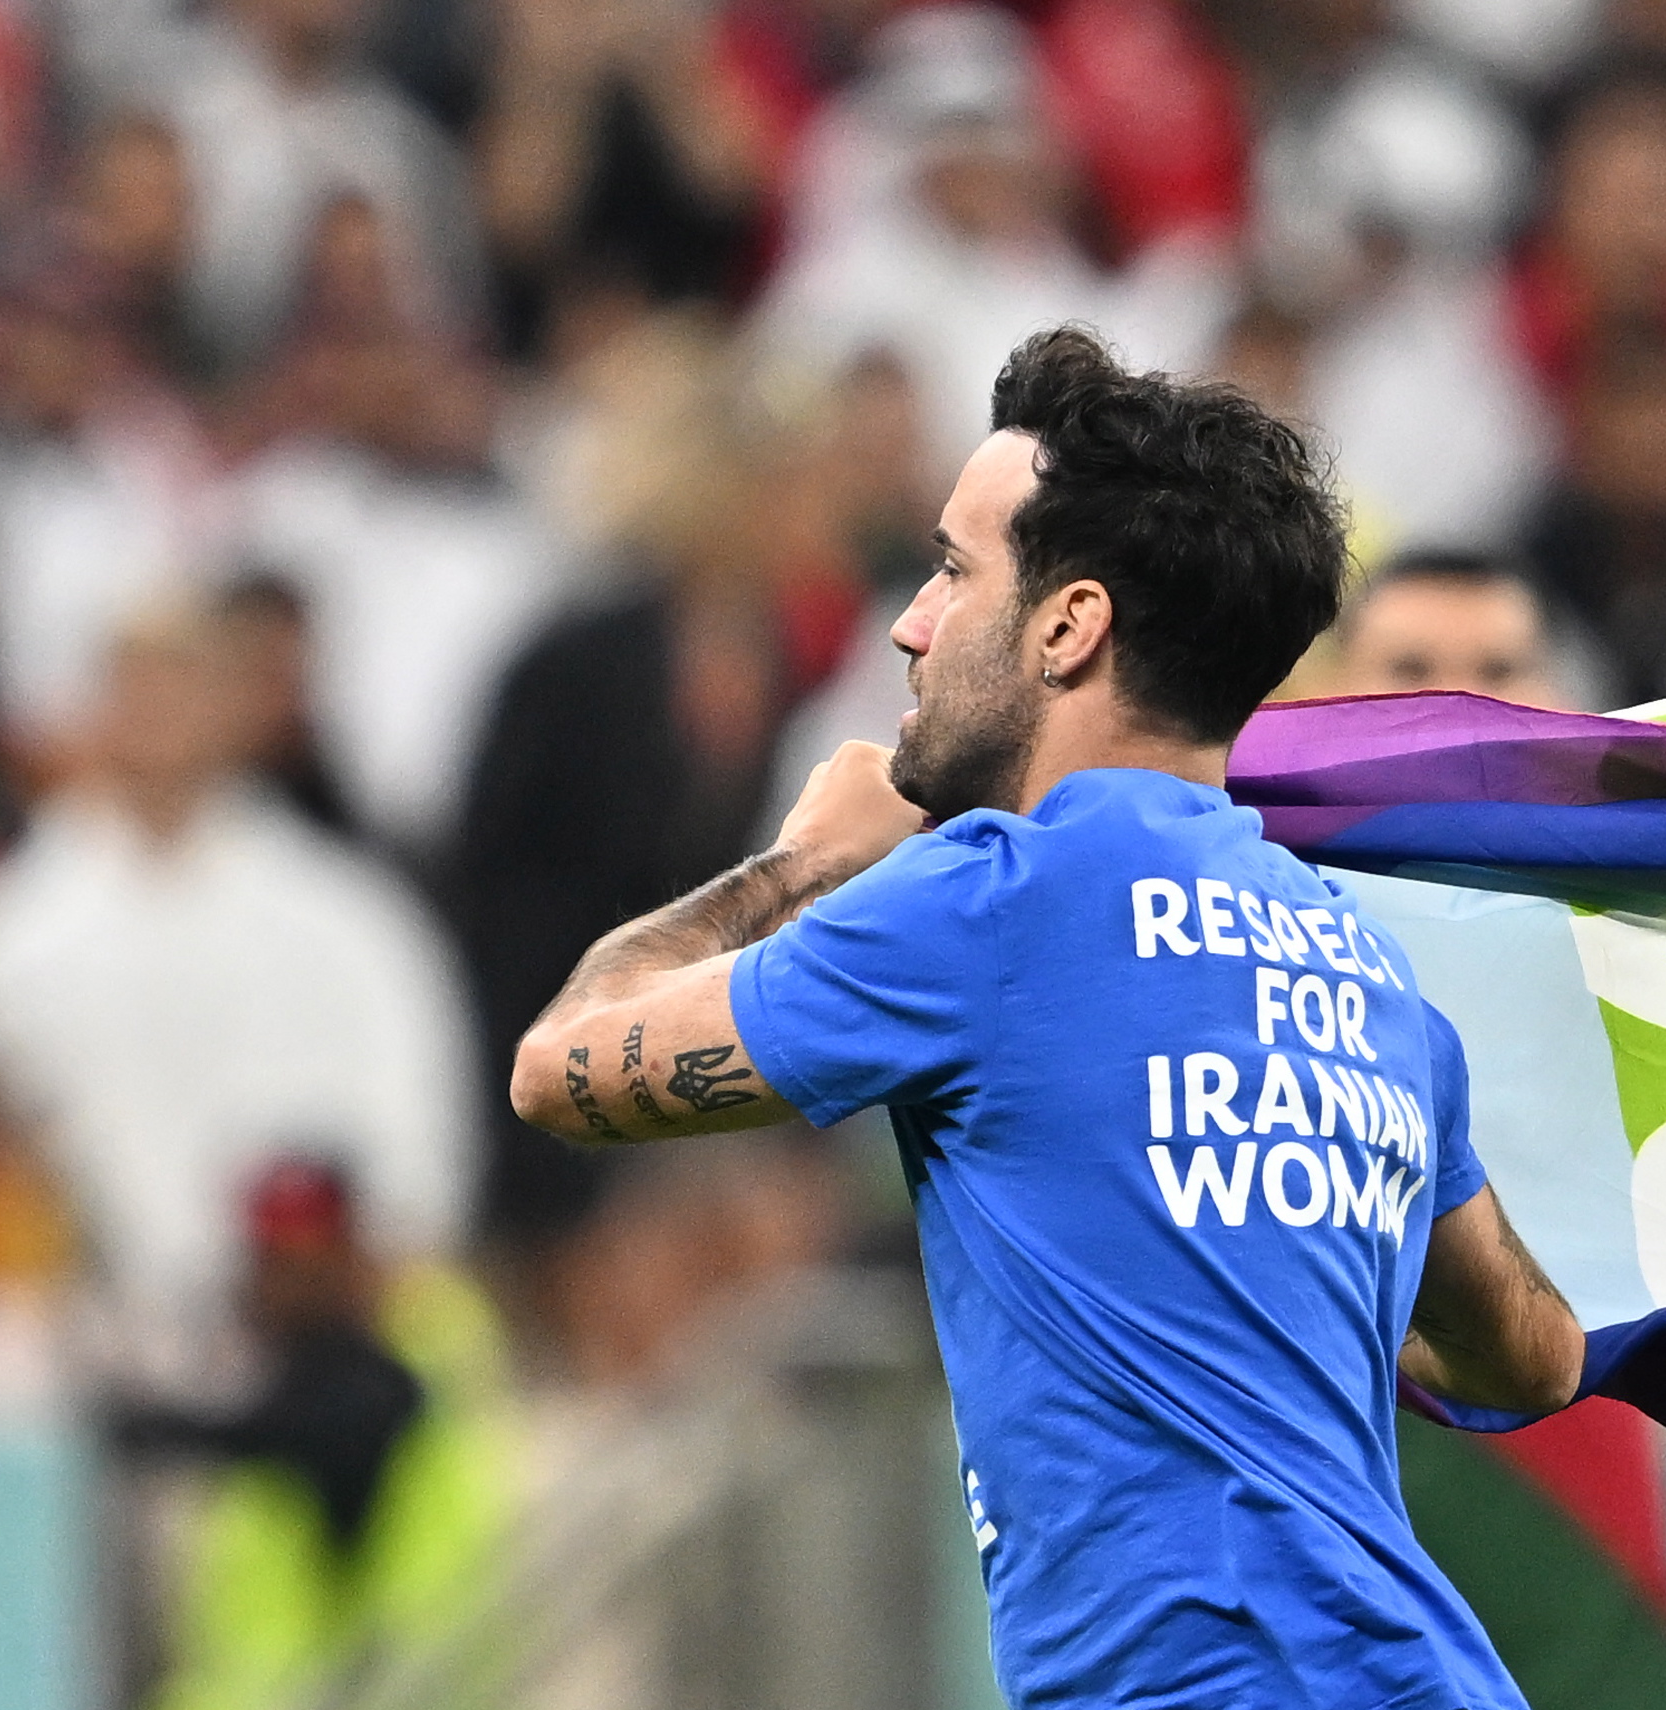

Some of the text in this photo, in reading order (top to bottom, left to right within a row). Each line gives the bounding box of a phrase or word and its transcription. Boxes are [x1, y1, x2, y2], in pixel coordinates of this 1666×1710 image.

[1131, 878, 1405, 991] RESPECT
[1255, 966, 1378, 1062] FOR
[1147, 1052, 1428, 1171] IRANIAN
[1146, 1141, 1426, 1252] WOMN
